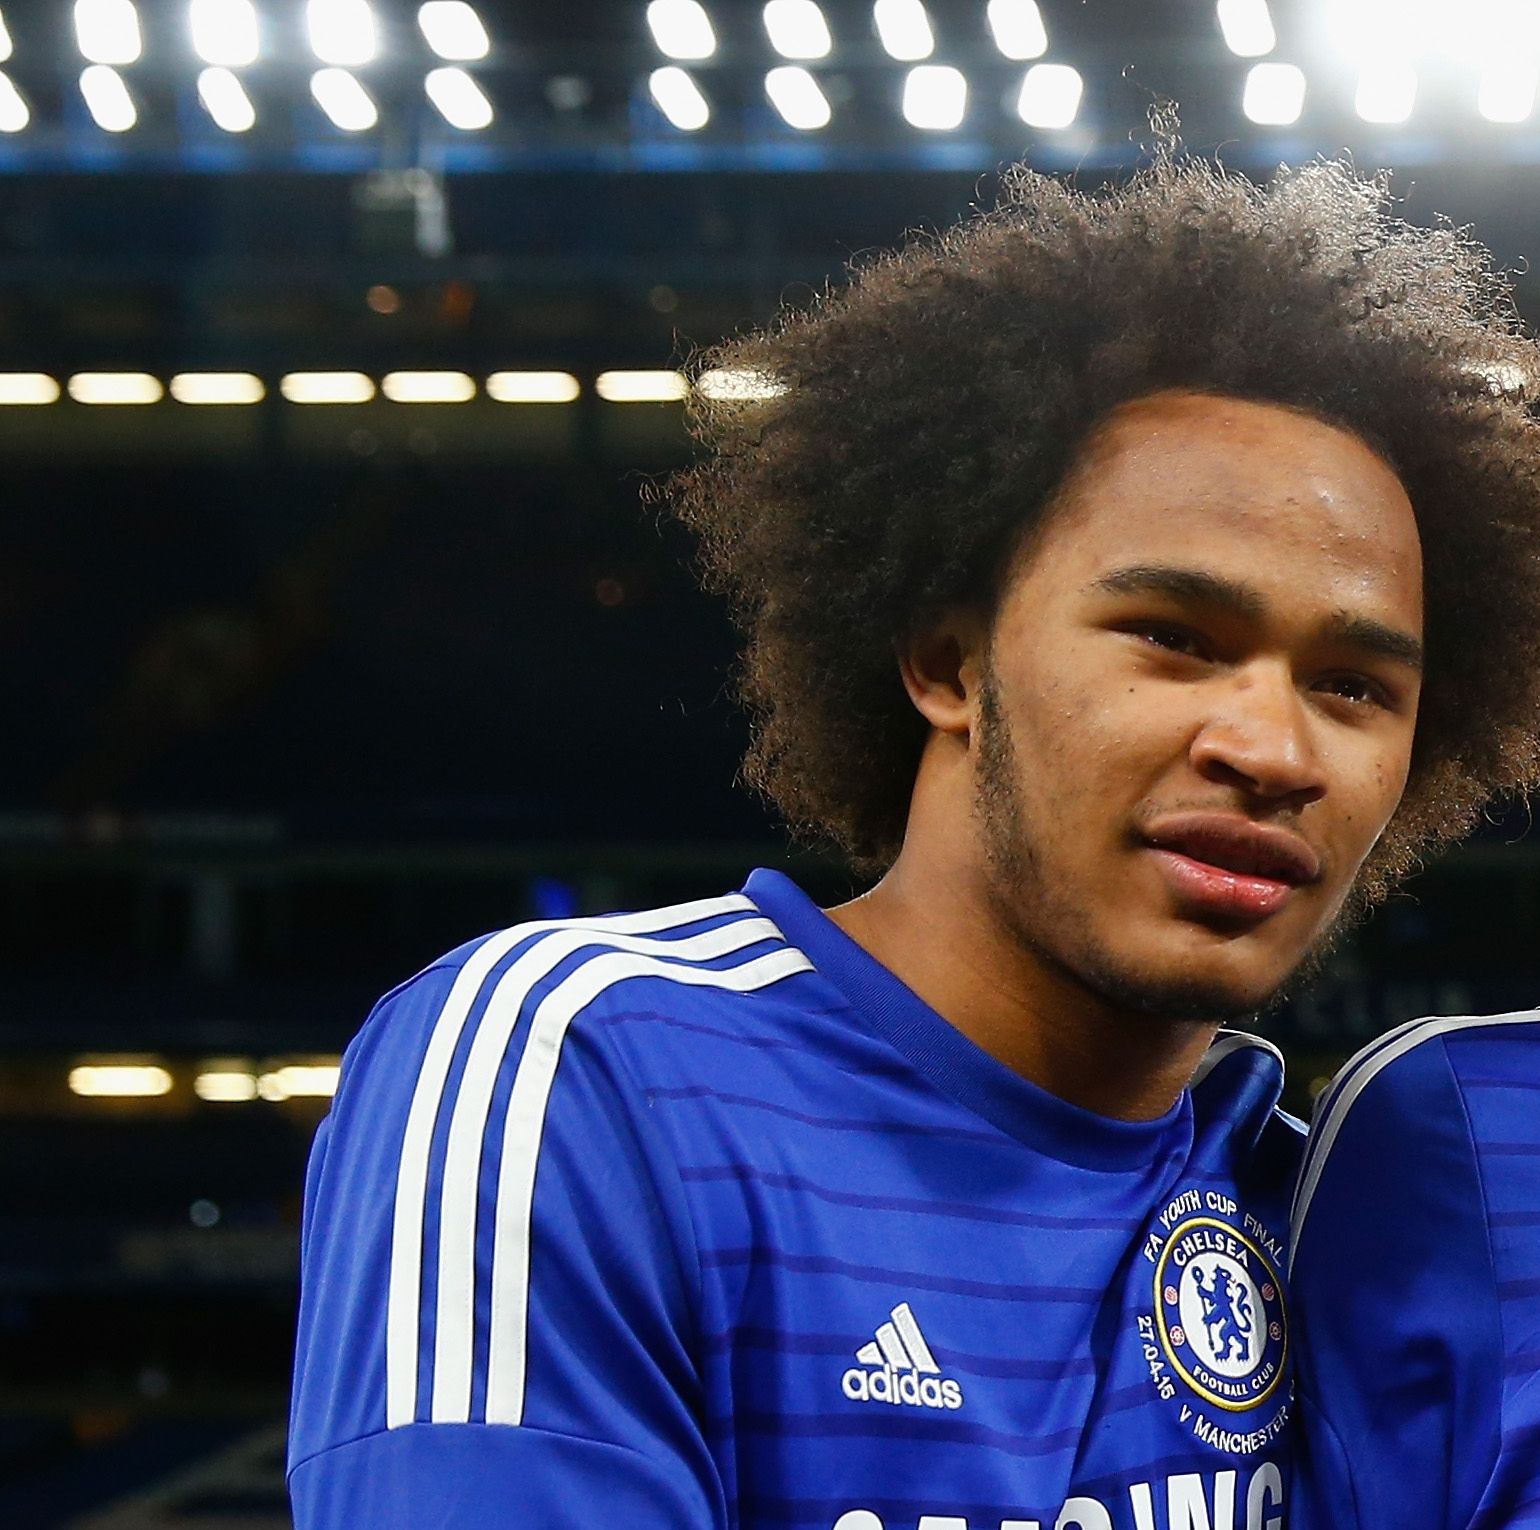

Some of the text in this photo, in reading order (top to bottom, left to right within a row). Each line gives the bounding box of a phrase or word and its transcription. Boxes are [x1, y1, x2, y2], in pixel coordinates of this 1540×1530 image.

[1143, 1190, 1283, 1268] FA YOUTH CUP FINAL
[1173, 1231, 1249, 1267] CHELSEA
[841, 1362, 965, 1410] adidas
[1192, 1364, 1249, 1398] FOOTBALL
[1251, 1361, 1275, 1391] CLUB
